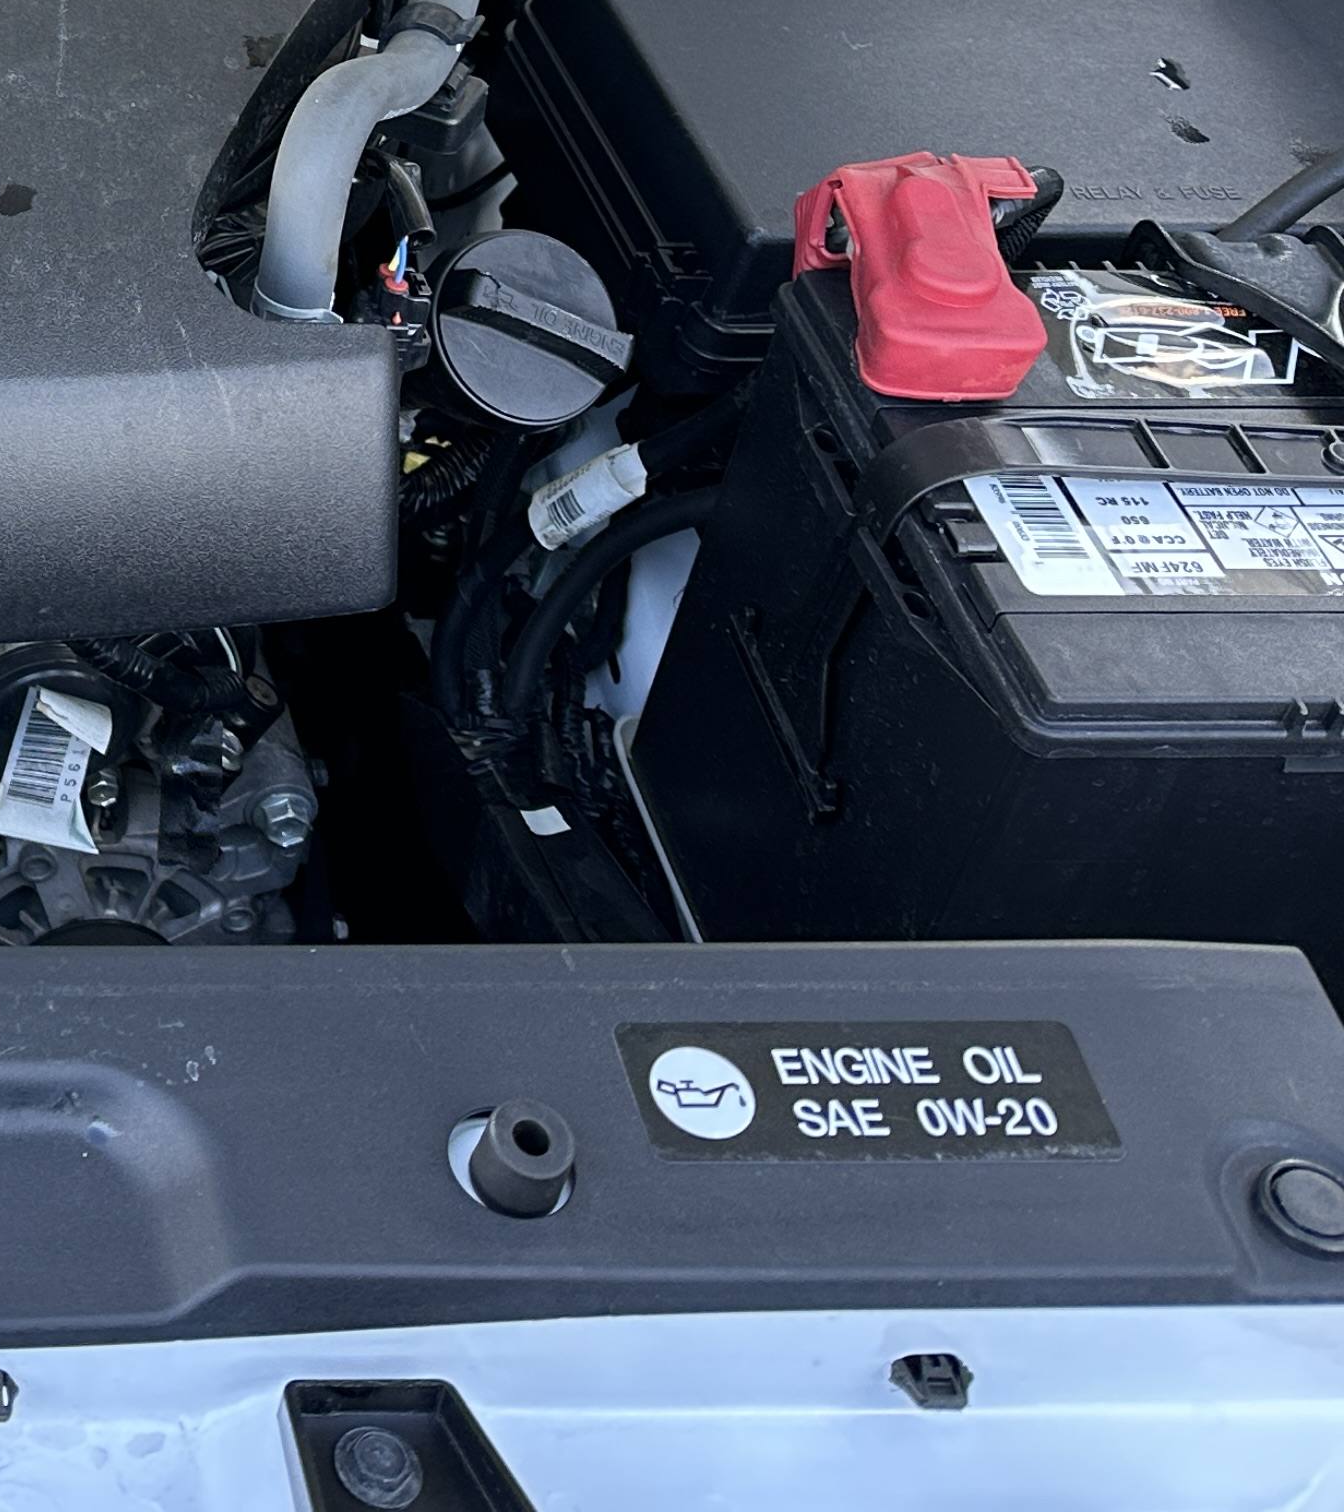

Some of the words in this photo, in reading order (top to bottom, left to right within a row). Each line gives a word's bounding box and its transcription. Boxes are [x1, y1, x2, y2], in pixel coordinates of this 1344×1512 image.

[1069, 183, 1144, 200] RELAY
[1178, 183, 1242, 201] FUSE
[1224, 487, 1251, 496] OPEN
[1253, 487, 1274, 496] NOT
[1095, 496, 1122, 506] RC
[1128, 496, 1149, 506] 115
[1121, 515, 1150, 525] 650
[1224, 511, 1252, 520] HELP
[1153, 535, 1185, 545] CCA
[1262, 558, 1291, 567] EYES
[771, 1047, 940, 1086] ENGINE
[963, 1046, 1042, 1085] OIL
[793, 1099, 890, 1139] SAE
[917, 1098, 1058, 1138] 0W-20
